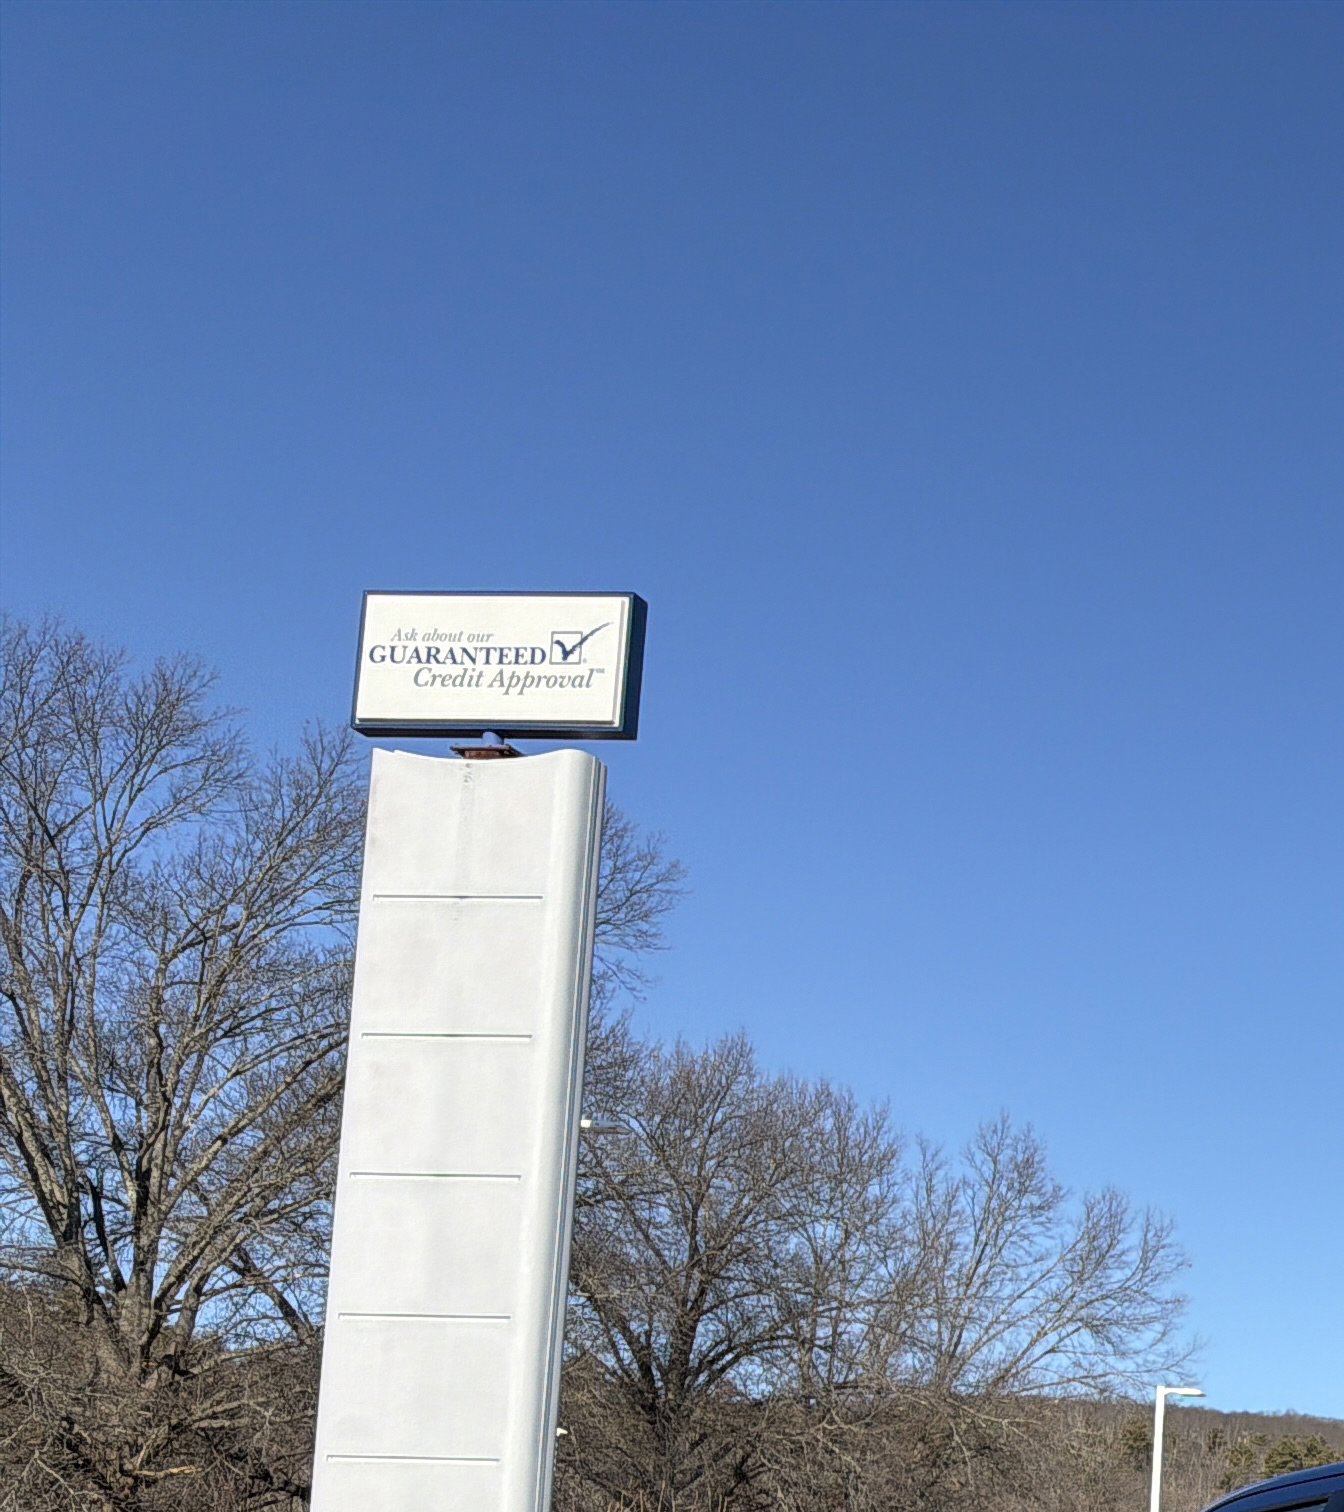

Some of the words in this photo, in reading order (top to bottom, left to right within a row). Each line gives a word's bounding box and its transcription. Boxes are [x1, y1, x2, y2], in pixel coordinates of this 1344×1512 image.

[391, 628, 417, 643] Ask
[422, 628, 465, 643] about
[467, 631, 494, 643] our
[369, 645, 547, 666] GUARANTEED
[413, 667, 484, 688] Credit
